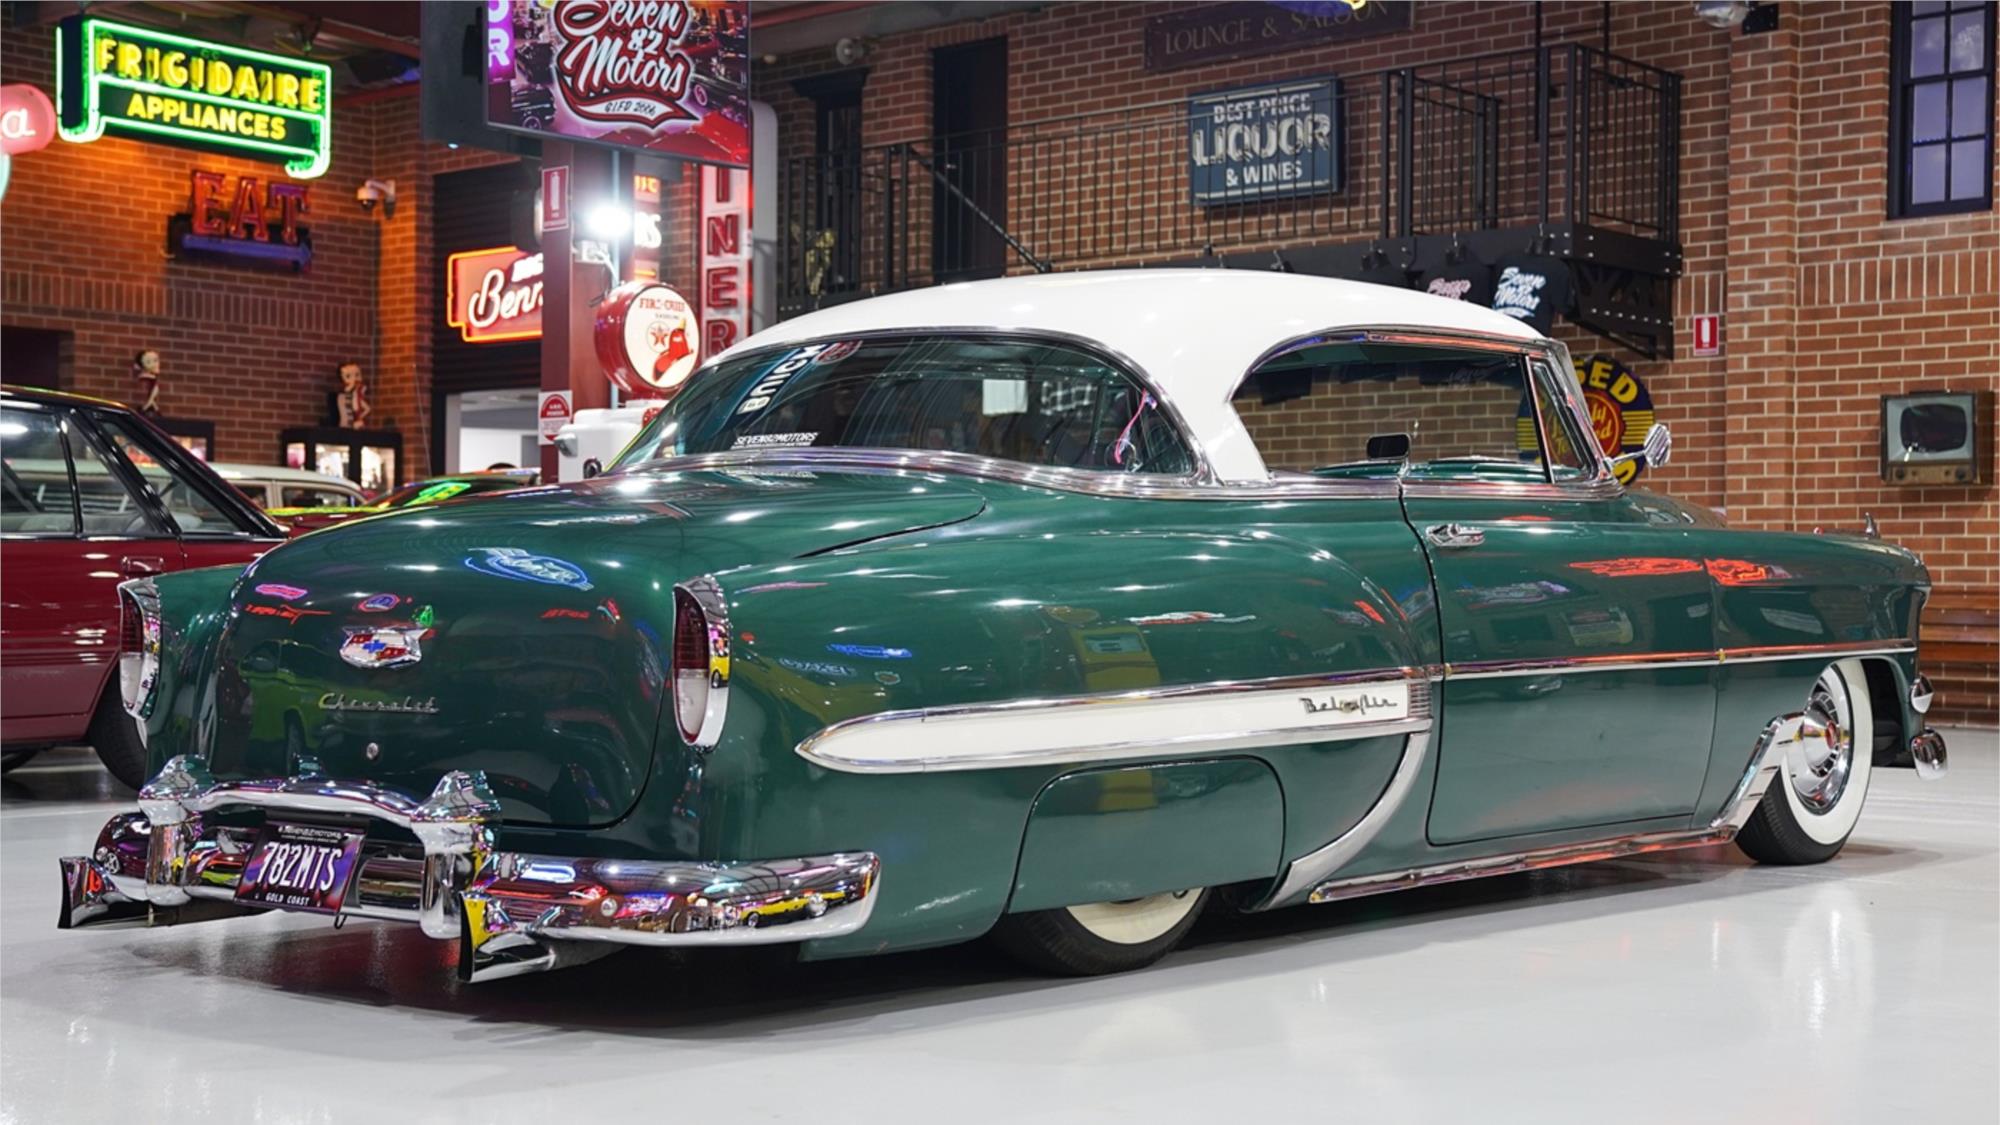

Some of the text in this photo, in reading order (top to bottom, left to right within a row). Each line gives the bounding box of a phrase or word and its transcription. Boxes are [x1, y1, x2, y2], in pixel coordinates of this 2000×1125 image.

[561, 0, 682, 36] Seven
[1165, 18, 1252, 54] LOUNGE
[1261, 16, 1280, 38] &
[627, 28, 663, 55] 82
[95, 37, 322, 111] FRIGIDAIRE
[563, 35, 685, 94] Motors
[127, 93, 287, 140] APPLIANCES
[1213, 93, 1311, 124] BEST PRICE
[1192, 113, 1332, 166] LIQUOR
[1226, 160, 1303, 187] & WINES
[191, 170, 311, 245] EAT
[256, 841, 342, 891] 782MTS
[265, 892, 310, 905] GOLD COAST
